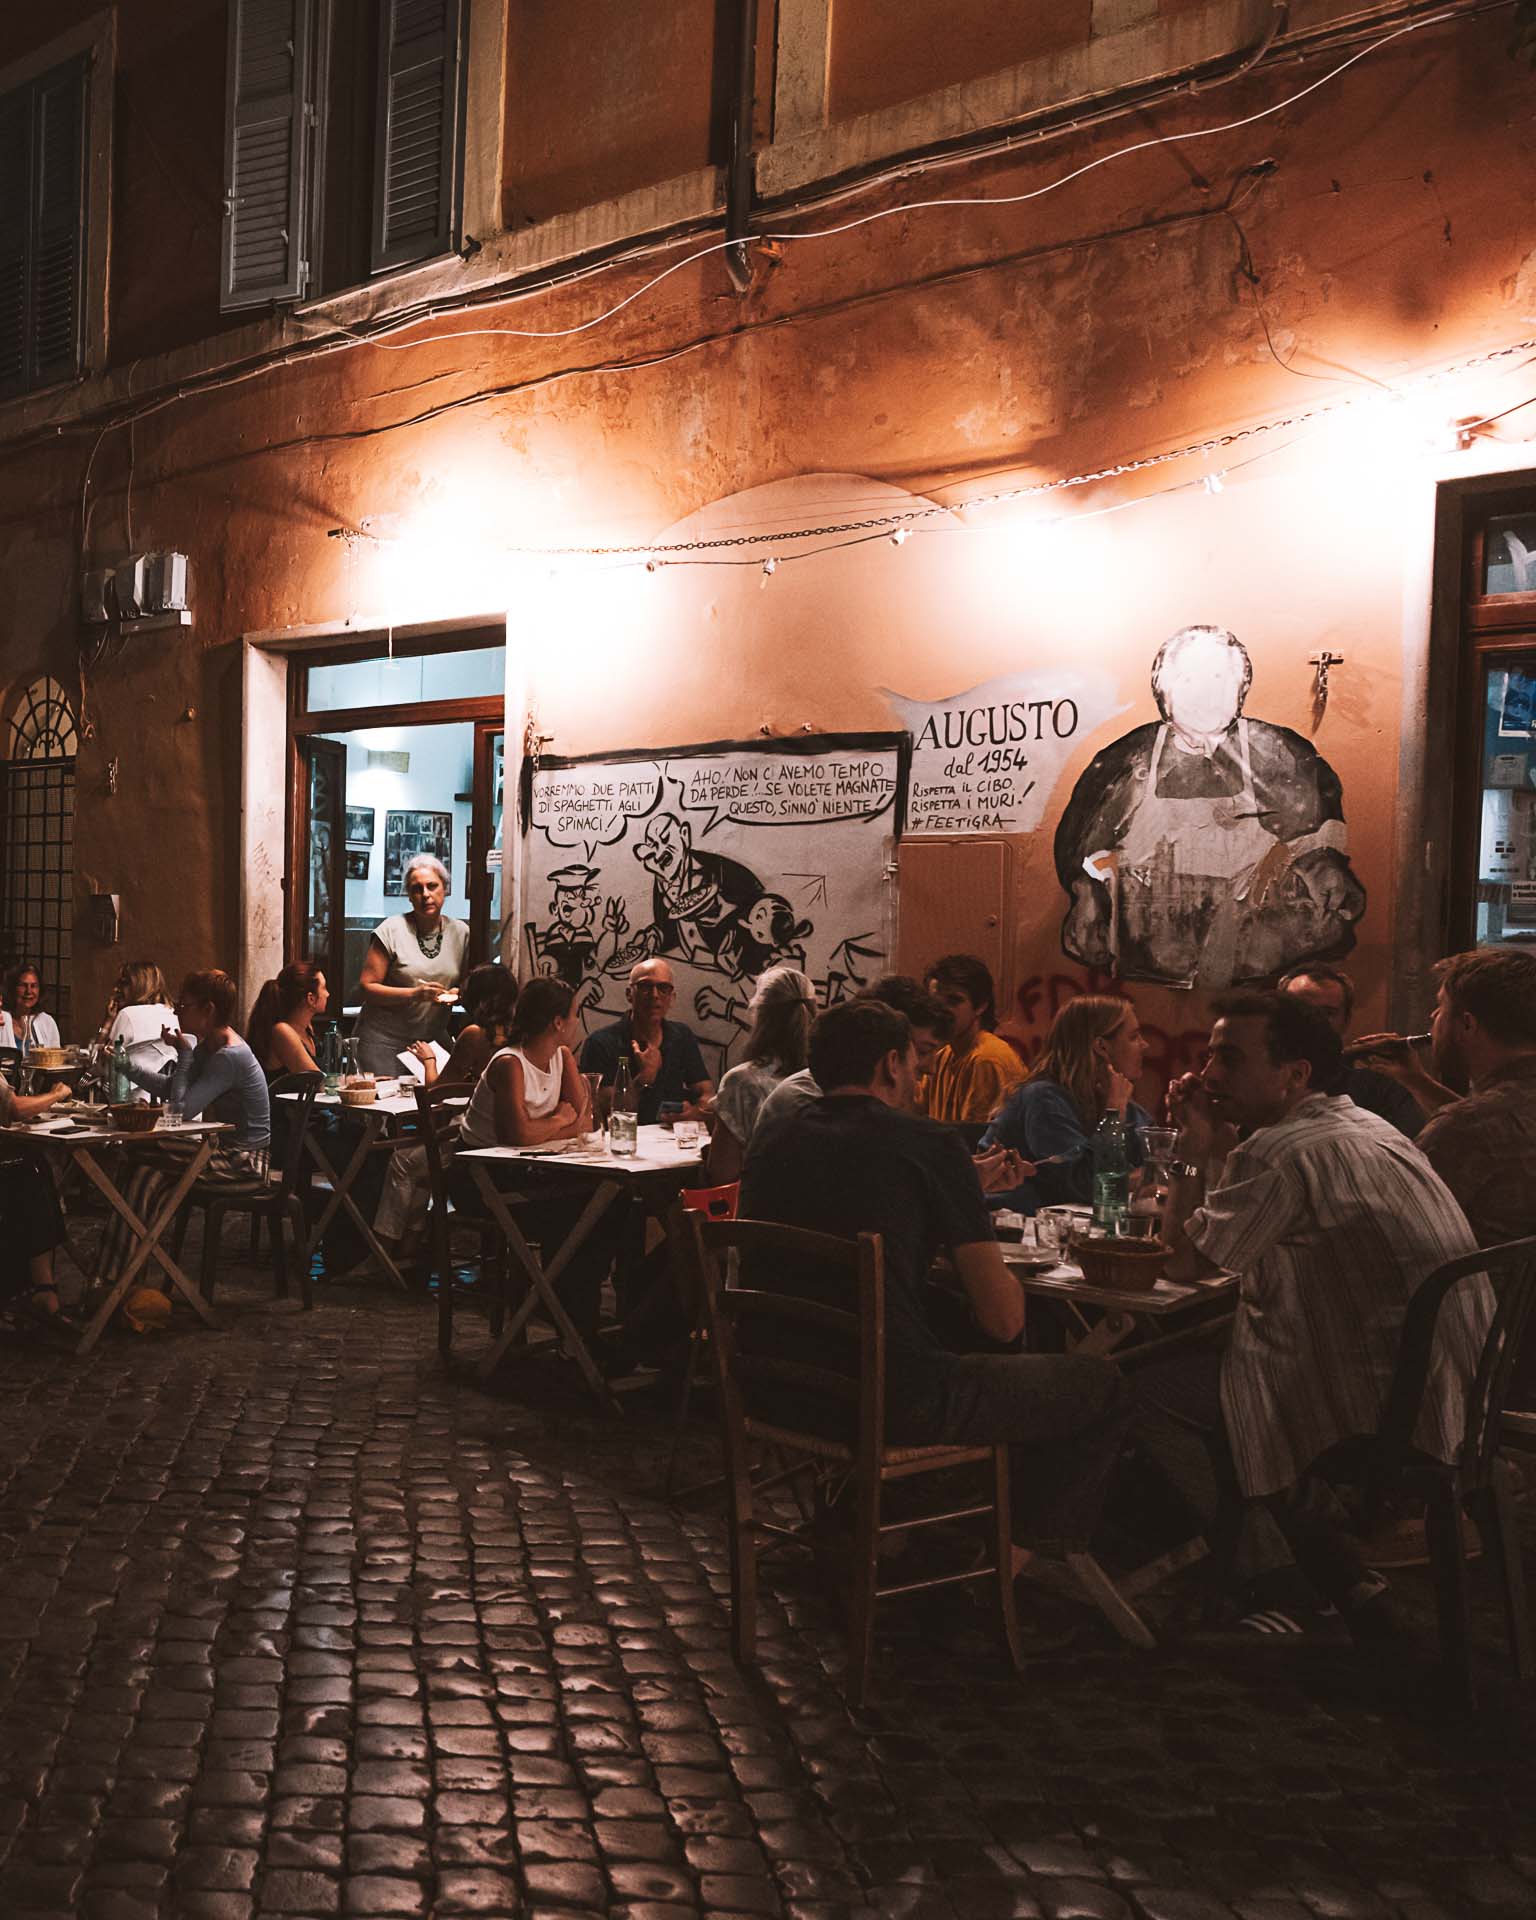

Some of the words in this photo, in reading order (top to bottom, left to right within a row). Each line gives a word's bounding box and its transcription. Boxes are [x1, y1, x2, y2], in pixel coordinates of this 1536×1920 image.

[915, 698, 1078, 750] AUGUSTO
[734, 766, 758, 782] NON
[779, 765, 825, 780] AVEMO
[829, 761, 884, 779] TEMPO
[944, 752, 975, 777] dal
[977, 748, 1028, 773] 1954
[533, 783, 586, 799] VORREMMO
[592, 782, 615, 796] DUE
[690, 788, 708, 803] DA
[788, 781, 832, 797] VOLETE
[836, 778, 896, 796] MAGNATE
[538, 801, 550, 814] DI
[617, 800, 641, 812] AGLI
[729, 800, 776, 816] QUESTO,
